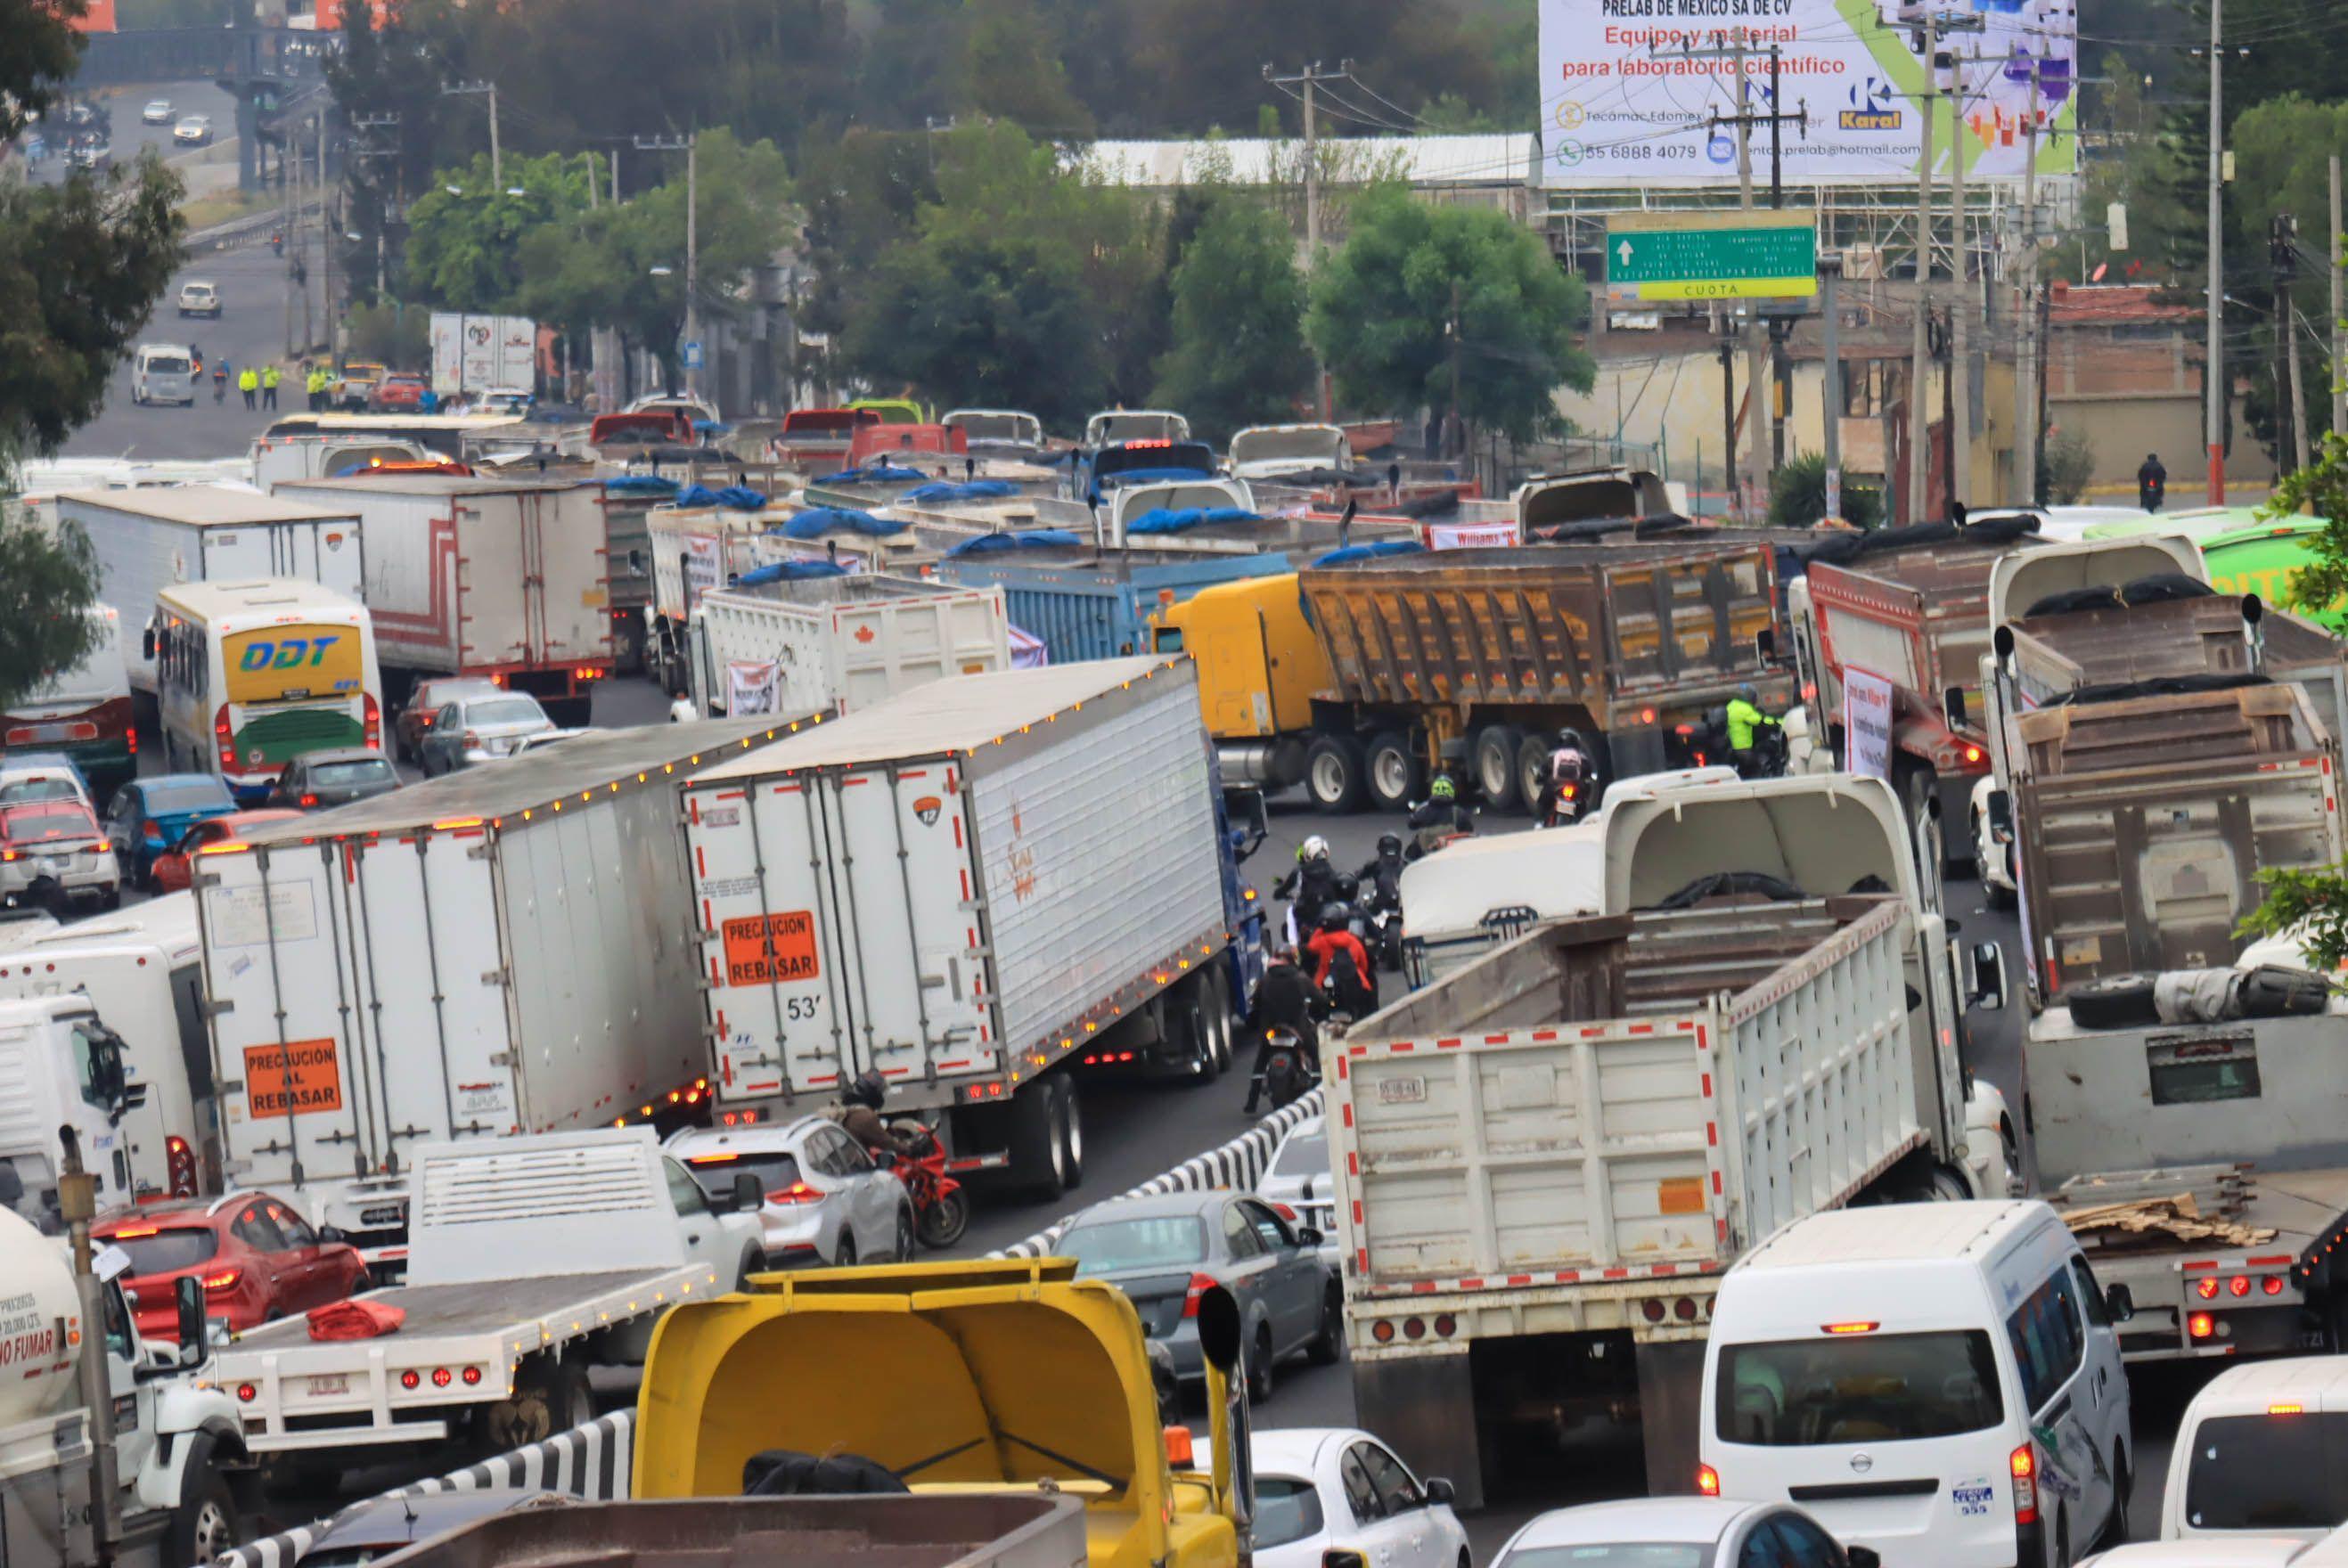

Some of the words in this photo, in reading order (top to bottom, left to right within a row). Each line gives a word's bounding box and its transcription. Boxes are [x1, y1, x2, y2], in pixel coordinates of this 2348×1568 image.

[1603, 0, 1653, 16] PRELAB
[1657, 0, 1673, 15] DE
[1732, 0, 1749, 15] SA
[1754, 0, 1771, 15] DE
[1774, 0, 1792, 15] CV
[1606, 26, 1682, 48] Equipo
[1689, 29, 1702, 46] y
[1563, 61, 1610, 80] para
[1617, 58, 1738, 77] laboratorio
[1840, 111, 1900, 129] Karal
[1585, 146, 1605, 159] 55
[1611, 146, 1651, 159] 6888
[1657, 146, 1697, 159] 4079
[1684, 284, 1739, 296] CUOTA
[240, 635, 340, 673] DDT
[762, 940, 780, 957] AL
[732, 955, 812, 980] REBASAR
[282, 1072, 305, 1086] AL
[254, 1087, 335, 1112] REBASAR
[13, 1328, 53, 1364] FUMAR
